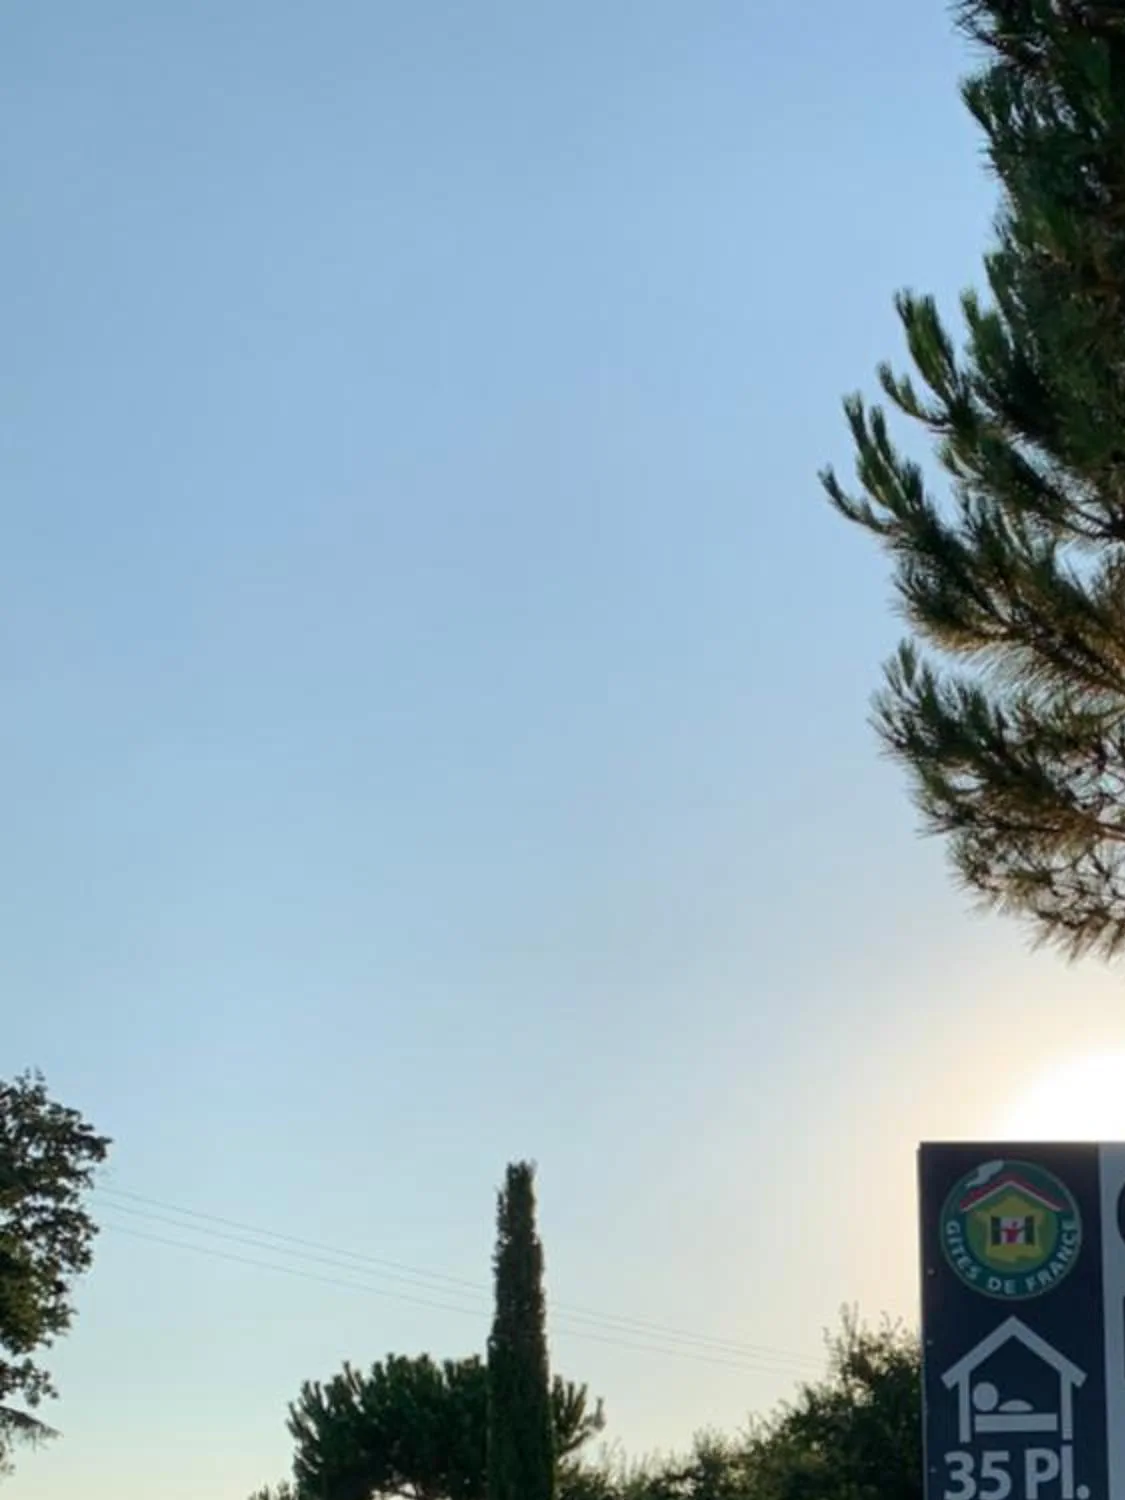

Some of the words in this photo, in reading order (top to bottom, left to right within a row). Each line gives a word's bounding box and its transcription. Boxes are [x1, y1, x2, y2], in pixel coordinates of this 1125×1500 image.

[987, 1277, 1016, 1294] DE
[1025, 1220, 1078, 1292] FRANCE
[1024, 1445, 1091, 1500] Pl.
